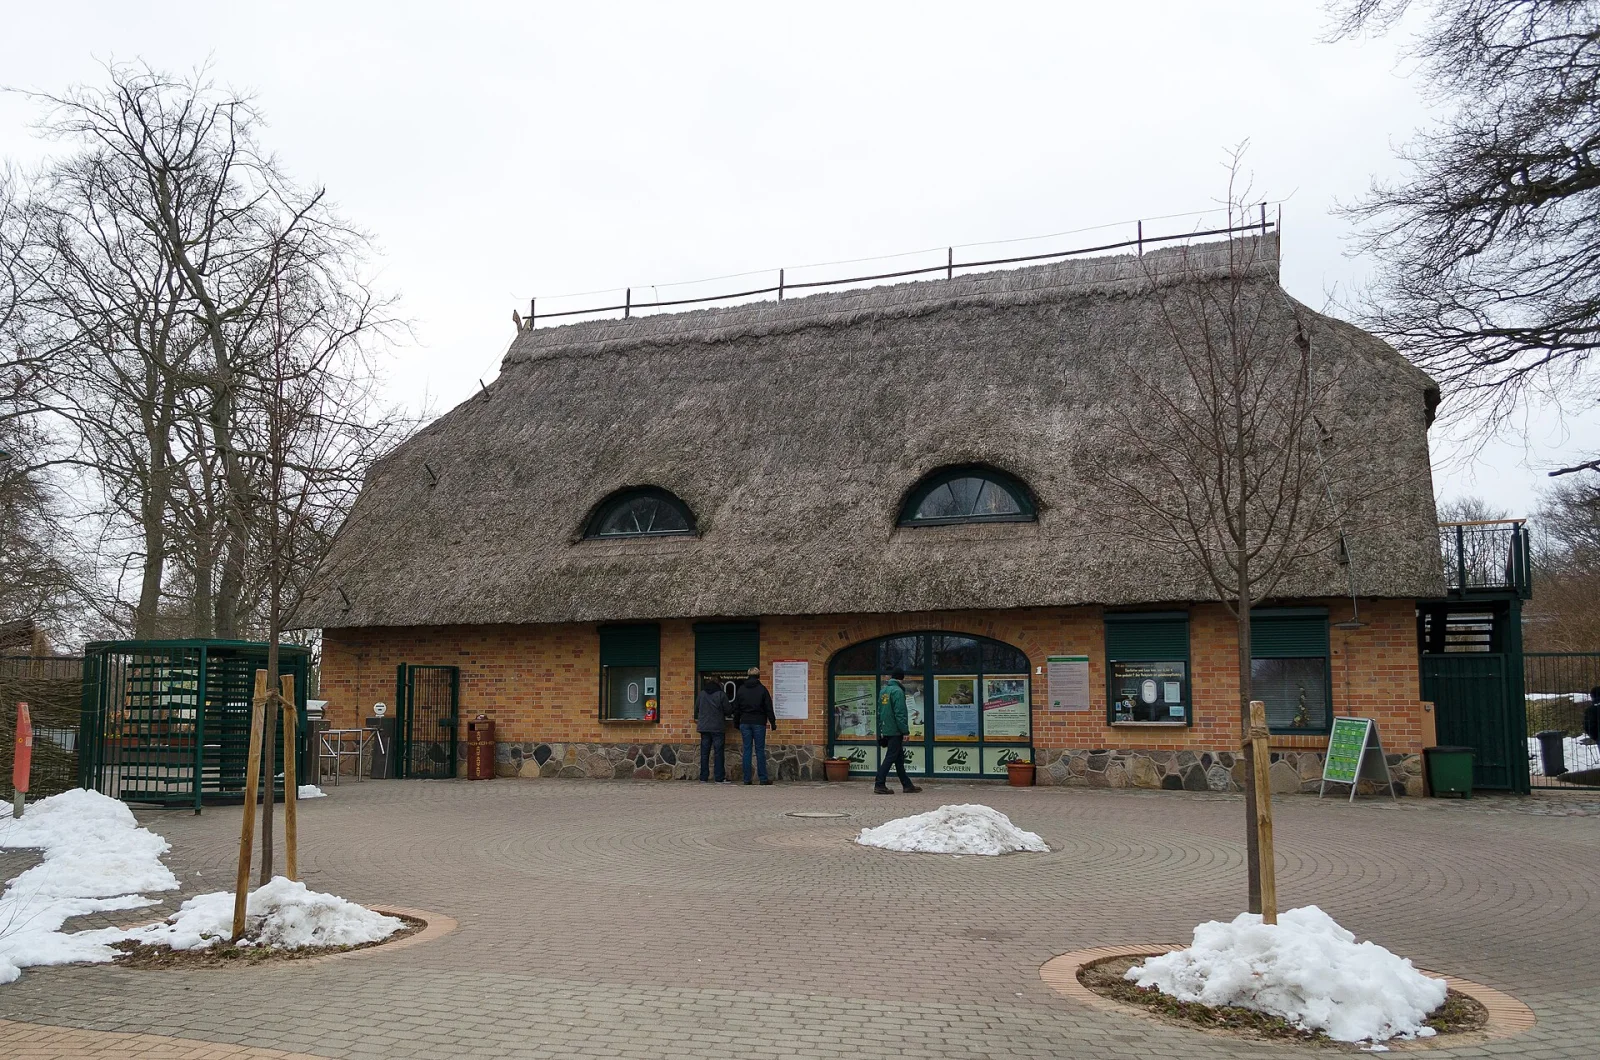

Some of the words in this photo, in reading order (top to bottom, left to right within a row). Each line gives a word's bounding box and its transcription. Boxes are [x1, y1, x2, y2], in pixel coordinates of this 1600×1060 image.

[1035, 666, 1042, 675] 1
[847, 747, 867, 763] Zoo
[947, 748, 968, 765] Zoo
[997, 748, 1019, 766] Zoo
